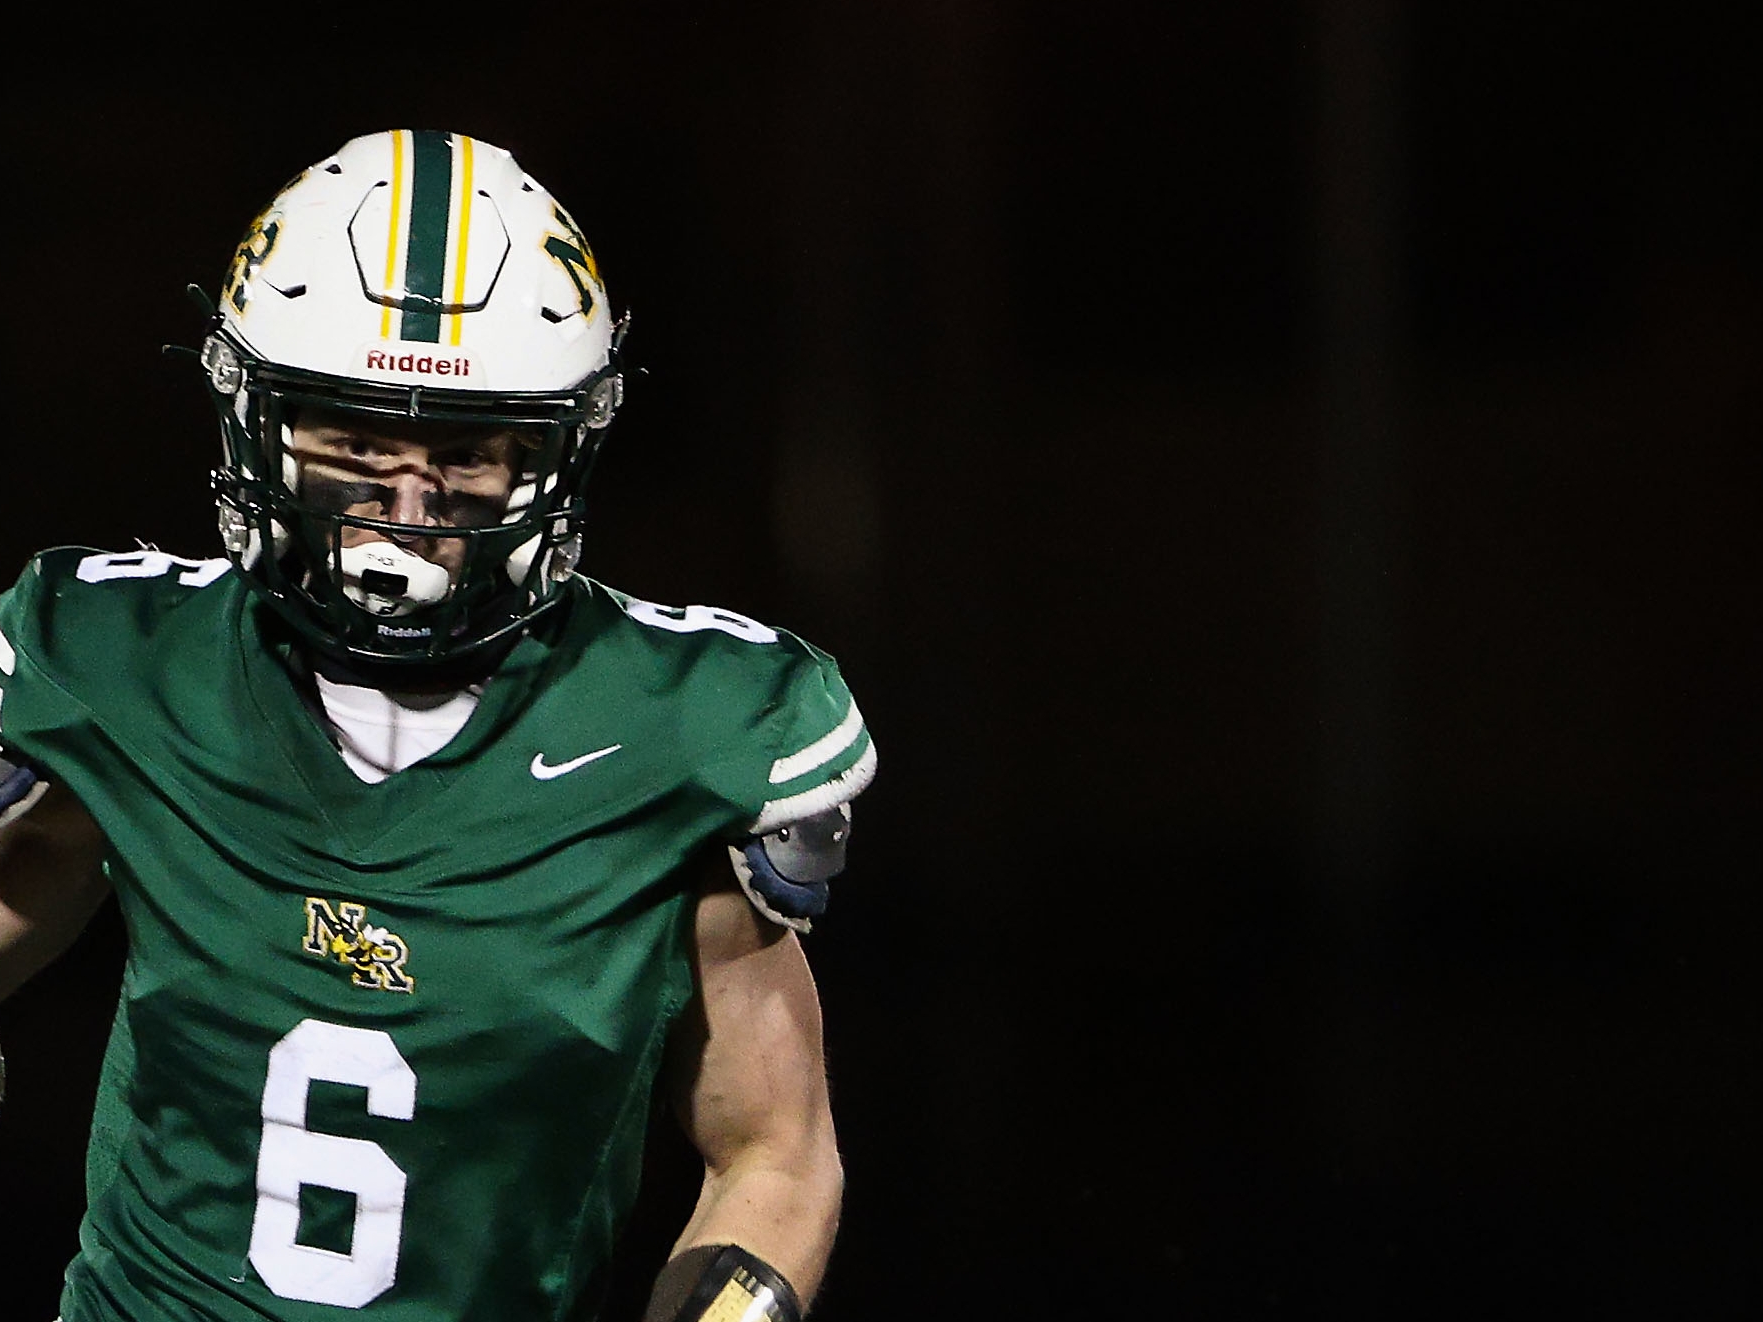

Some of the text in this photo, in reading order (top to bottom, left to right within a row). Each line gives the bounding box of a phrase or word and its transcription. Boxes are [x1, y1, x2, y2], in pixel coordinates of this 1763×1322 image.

[366, 350, 470, 376] Riddell
[302, 897, 415, 994] NR
[247, 1018, 418, 1310] 6
